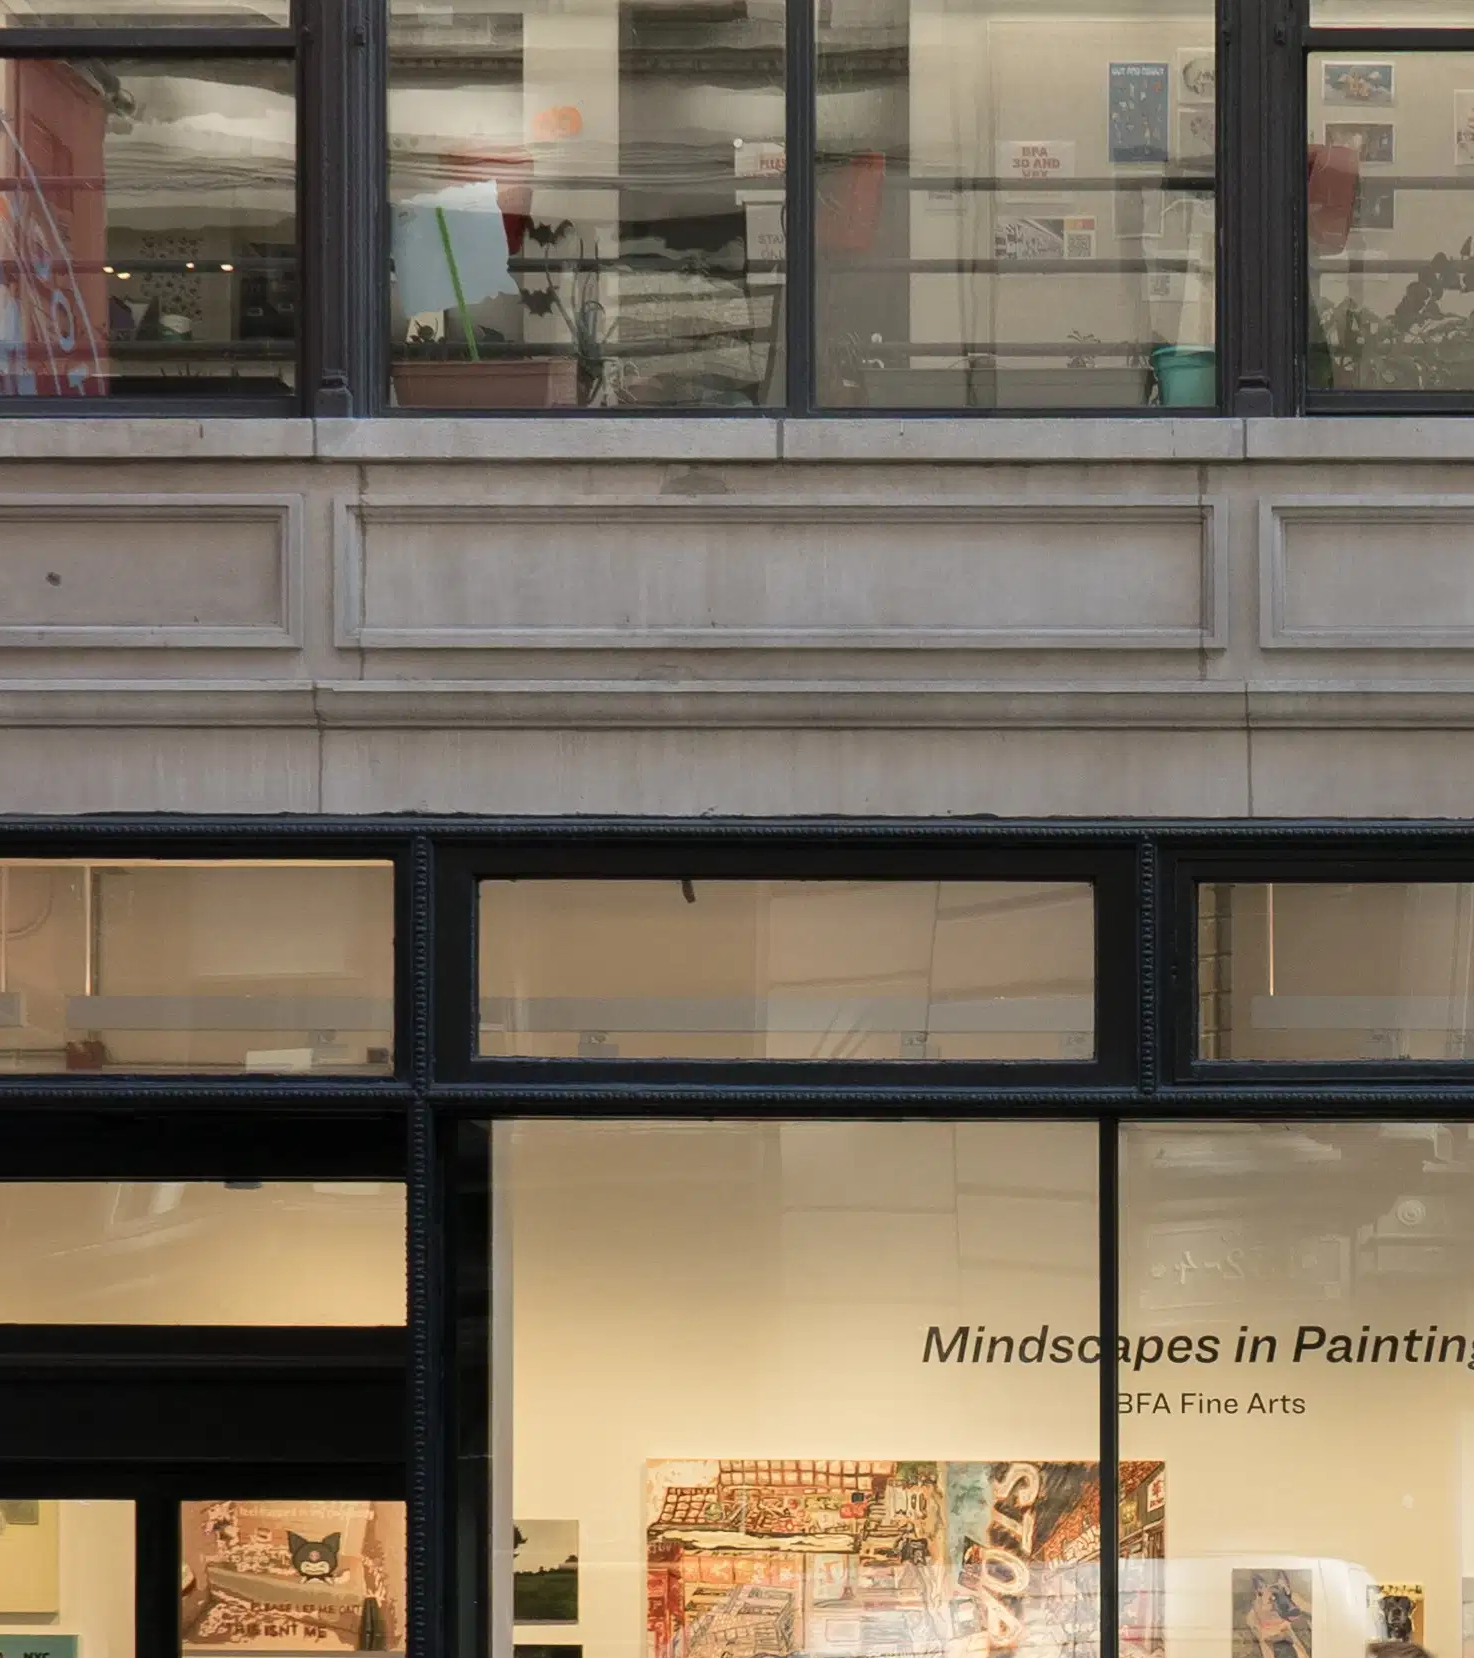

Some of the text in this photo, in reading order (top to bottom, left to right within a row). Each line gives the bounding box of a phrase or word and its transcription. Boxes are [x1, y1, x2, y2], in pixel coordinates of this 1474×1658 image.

[922, 1325, 1221, 1371] Mindscapes
[1234, 1325, 1278, 1364] in
[1117, 1393, 1306, 1414] BFA Fine Arts
